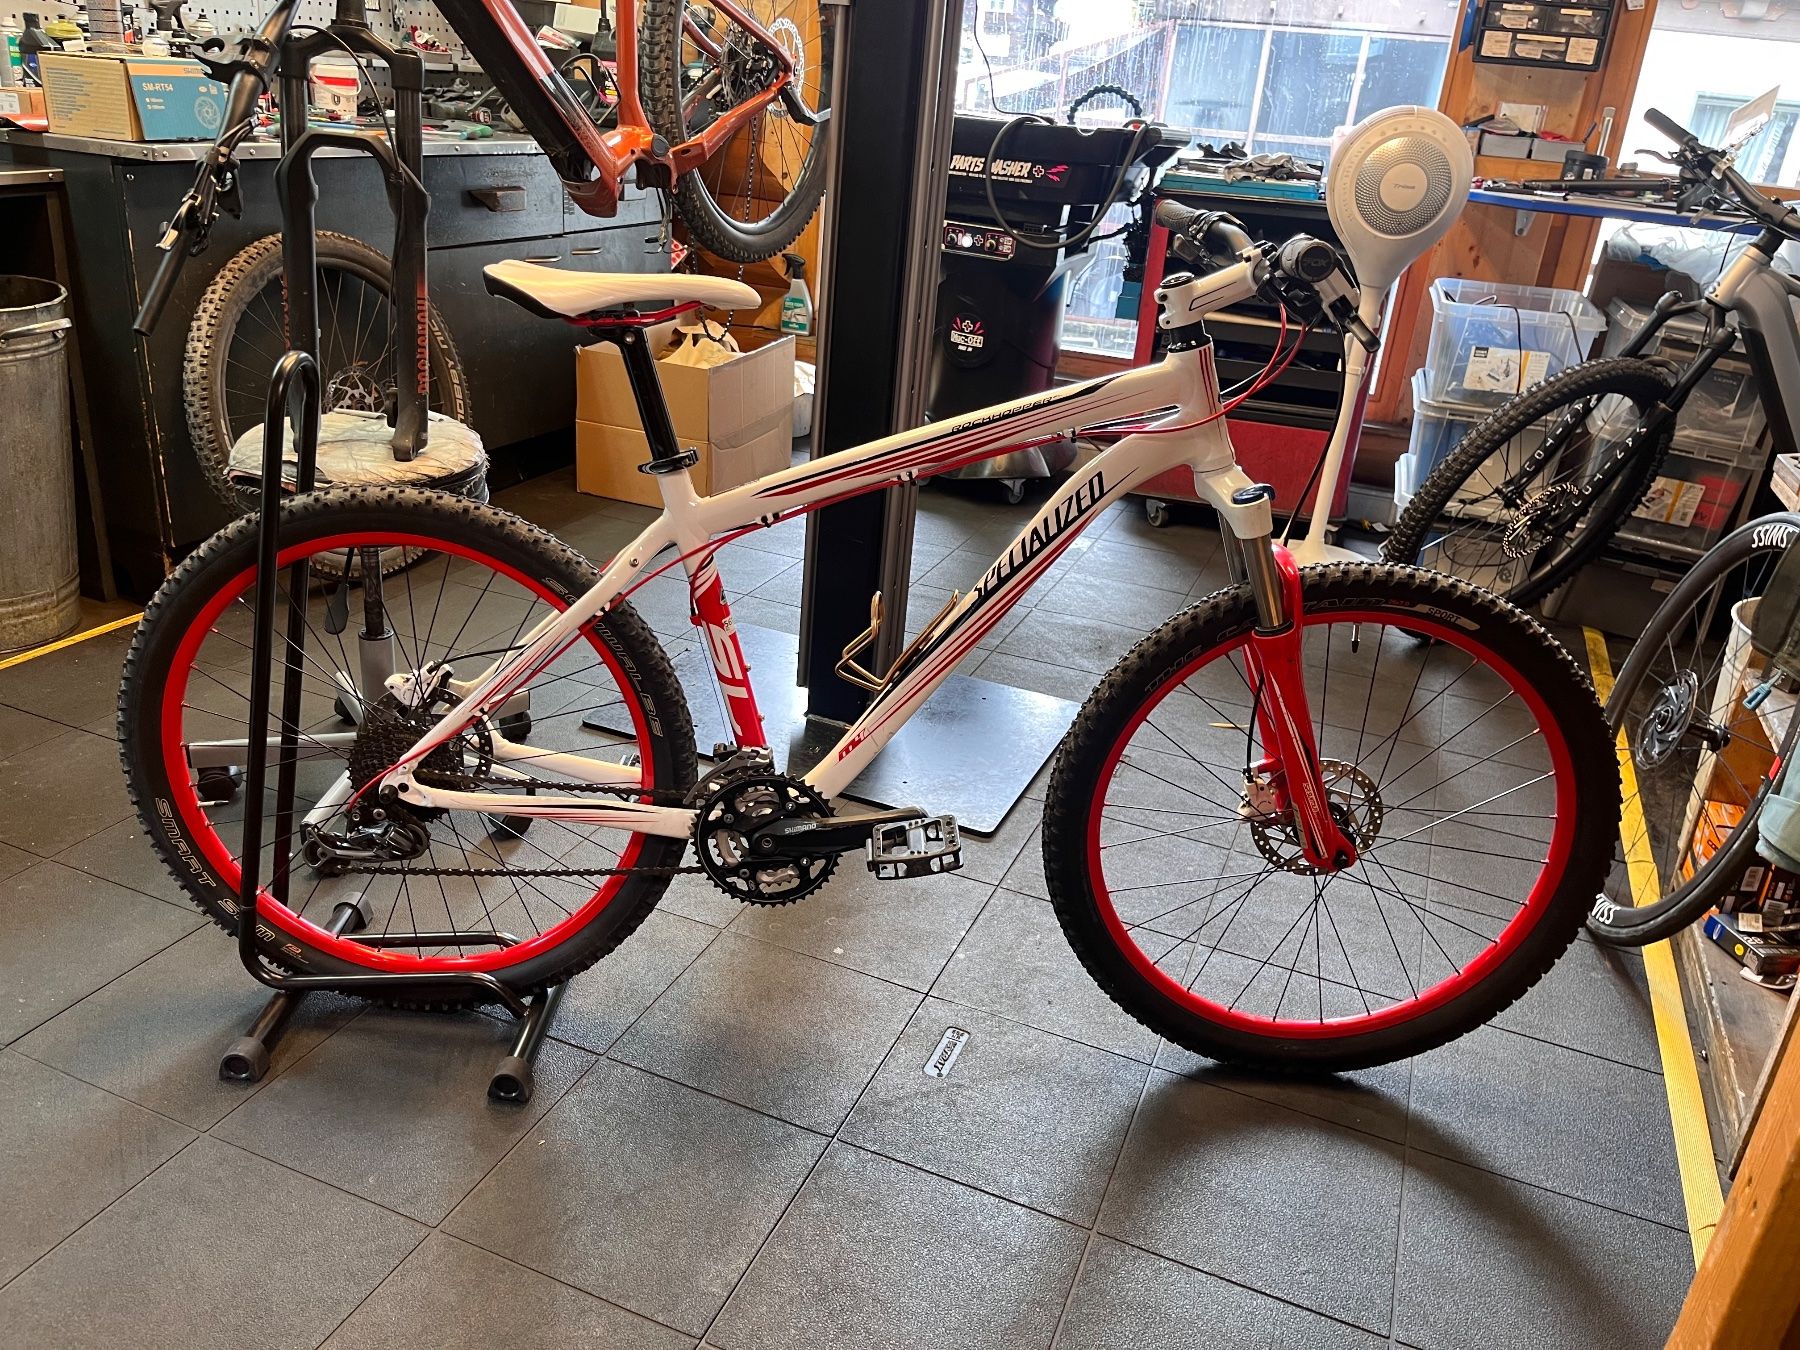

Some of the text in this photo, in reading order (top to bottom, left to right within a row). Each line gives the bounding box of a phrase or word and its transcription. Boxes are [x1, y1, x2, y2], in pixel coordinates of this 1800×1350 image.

[142, 82, 174, 92] SM-RT54
[950, 154, 985, 172] PARTS
[428, 318, 449, 350] NIC
[973, 470, 1105, 599] SPECIALIZED
[1751, 524, 1792, 549] SWISS
[1427, 606, 1462, 624] SPORT
[701, 619, 749, 737] SL
[784, 822, 817, 834] SHIMANO
[155, 797, 276, 943] SMART SM
